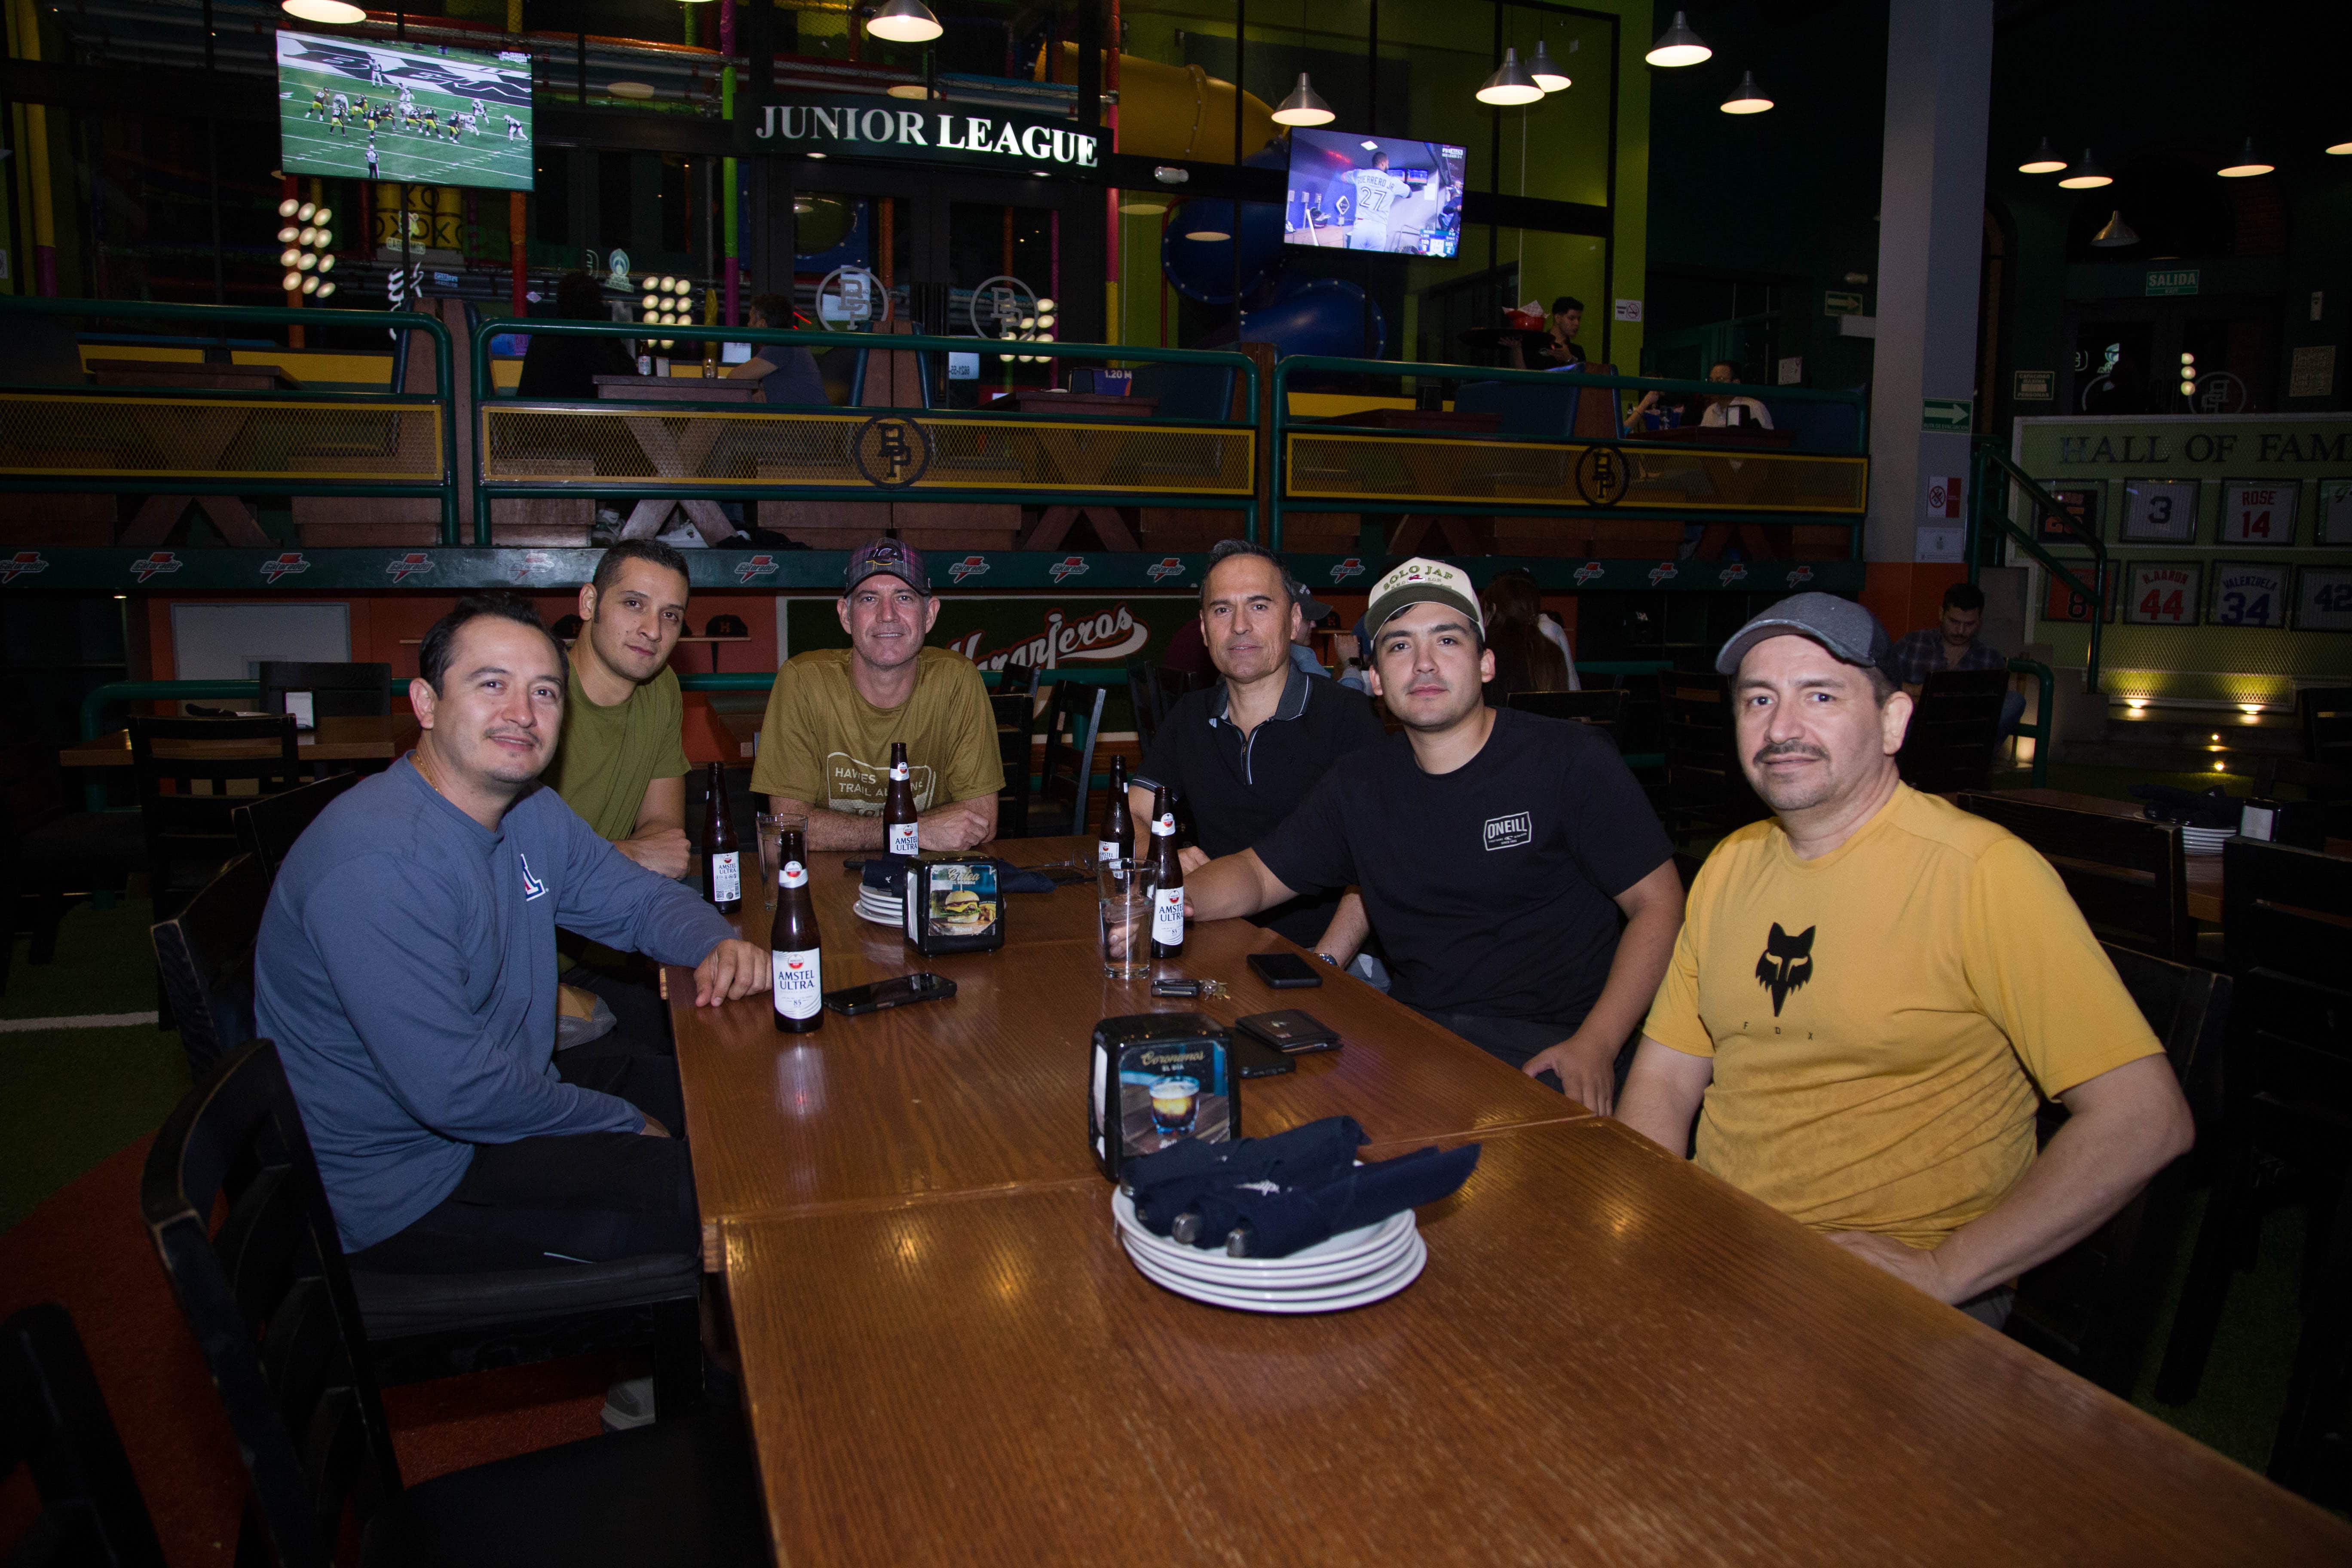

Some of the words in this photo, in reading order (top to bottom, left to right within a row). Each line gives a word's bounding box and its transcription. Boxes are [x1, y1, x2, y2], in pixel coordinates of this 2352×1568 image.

[756, 105, 928, 146] JUNIOR
[936, 114, 1099, 168] LEAGUE
[1359, 186, 1387, 211] 27
[2149, 273, 2196, 287] SALIDA
[1104, 370, 1122, 379] 1.20
[2060, 435, 2170, 464] HALL
[2184, 434, 2238, 463] OF
[2242, 490, 2277, 506] ROSE
[2149, 496, 2172, 524] 3
[2242, 511, 2271, 538] 14
[1383, 565, 1420, 591] SOLO
[2223, 576, 2278, 592] VALENZUELA
[2140, 589, 2184, 621] 44
[2221, 592, 2270, 627] 34
[839, 782, 872, 796] TRAIL
[895, 836, 917, 845] AMSTEL
[778, 970, 815, 980] AMSTEL
[780, 980, 815, 990] ULTRA
